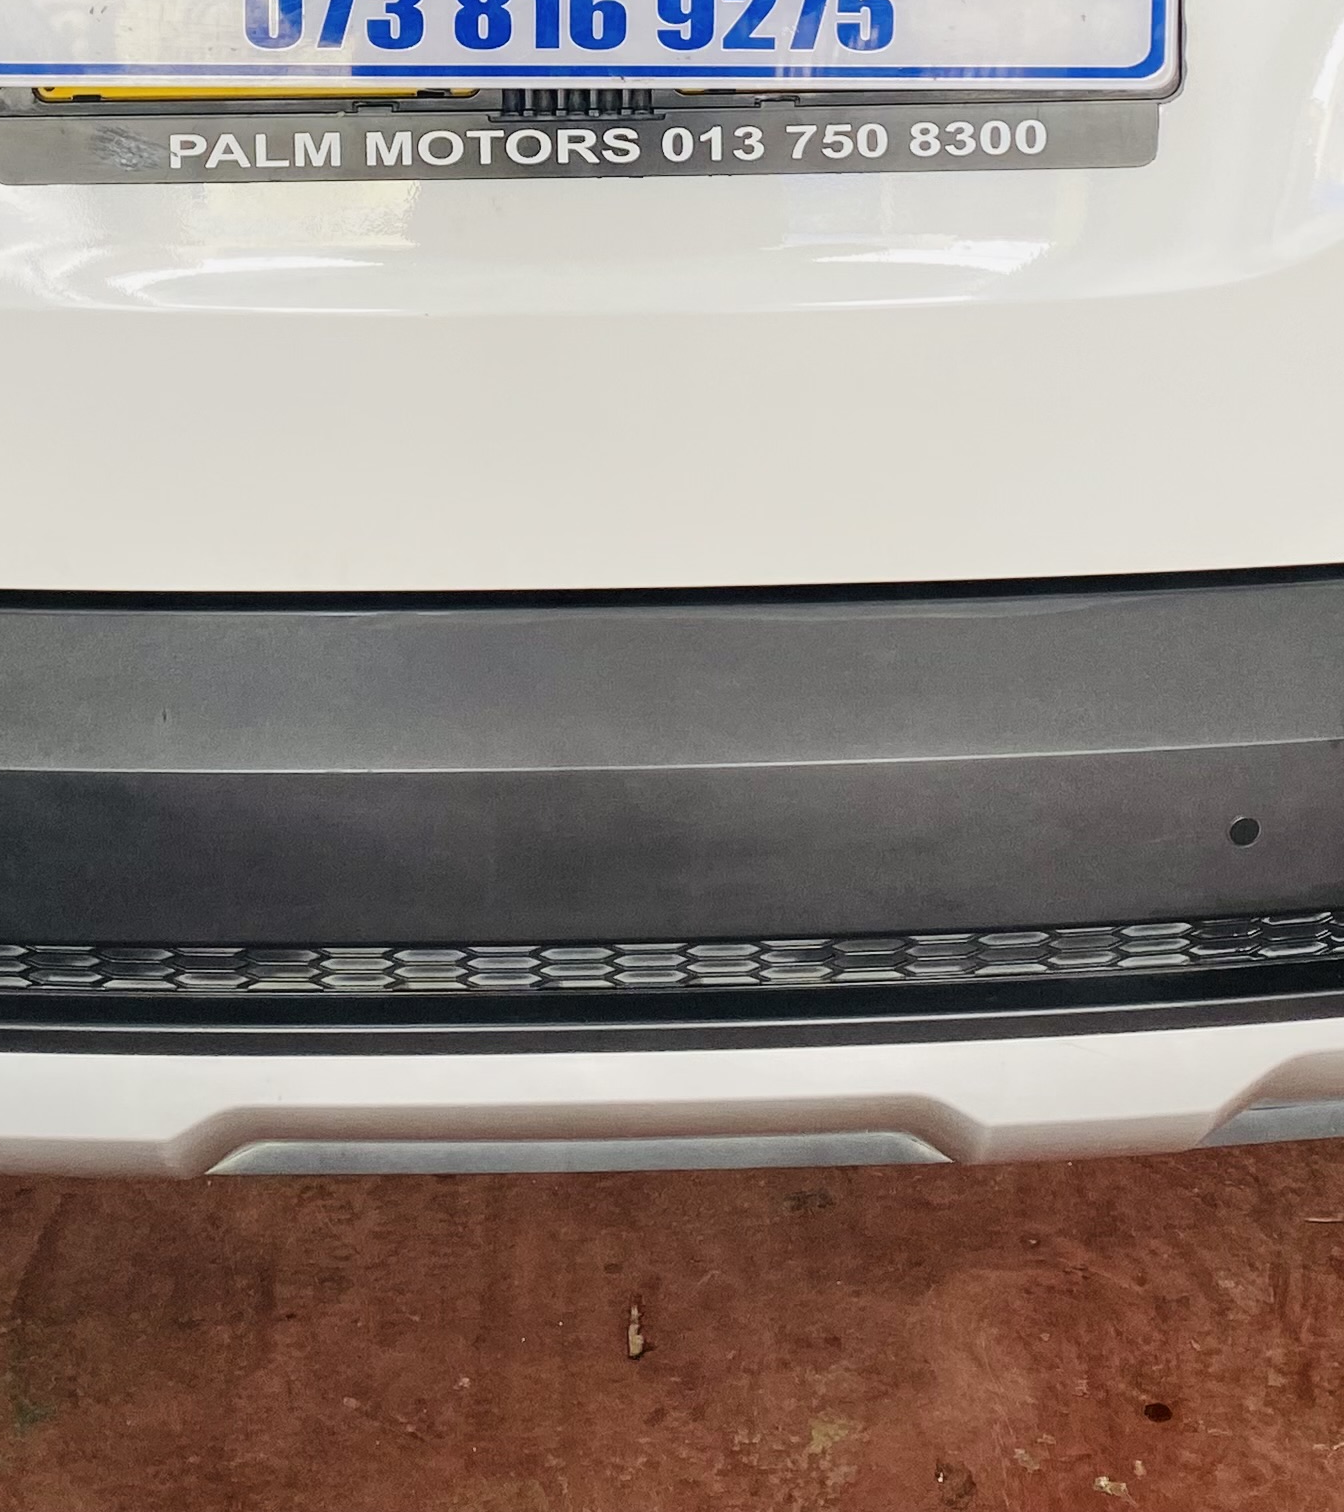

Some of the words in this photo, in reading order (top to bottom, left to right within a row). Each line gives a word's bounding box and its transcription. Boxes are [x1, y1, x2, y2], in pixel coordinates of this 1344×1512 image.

[168, 130, 343, 170] PALM
[364, 126, 642, 167] MOTORS
[660, 123, 767, 164] 013
[784, 121, 890, 161] 750
[908, 118, 1049, 158] 8300
